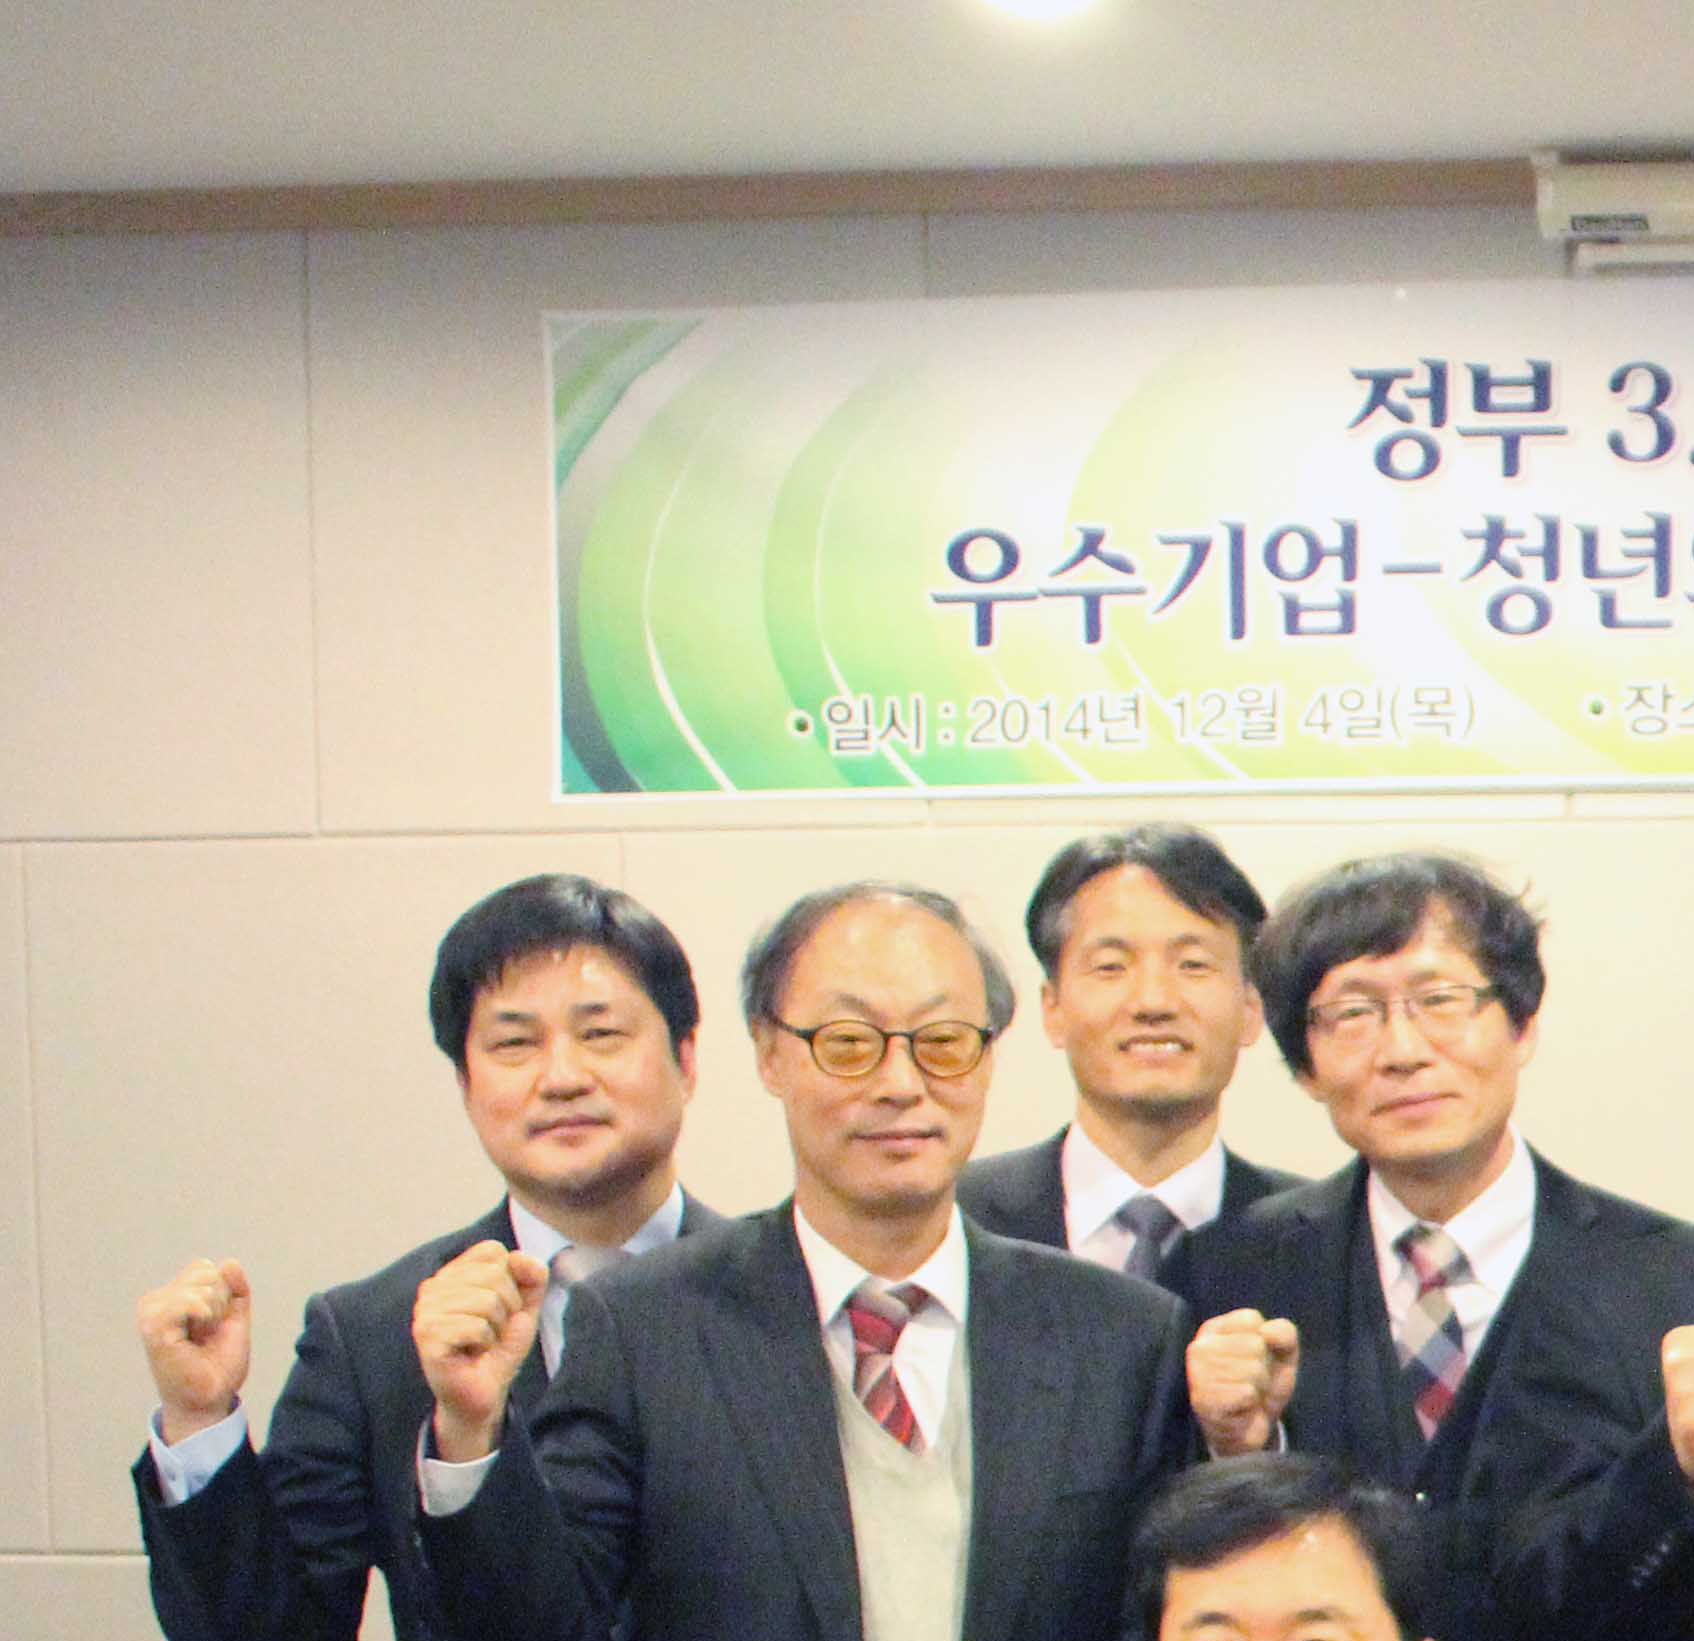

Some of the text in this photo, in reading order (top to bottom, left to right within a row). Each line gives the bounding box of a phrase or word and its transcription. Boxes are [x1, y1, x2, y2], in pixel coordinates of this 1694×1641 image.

[1347, 356, 1568, 482] 정부
[968, 696, 1144, 745] 2014년
[1172, 689, 1281, 742] 12월
[1303, 684, 1476, 742] 4일(목)
